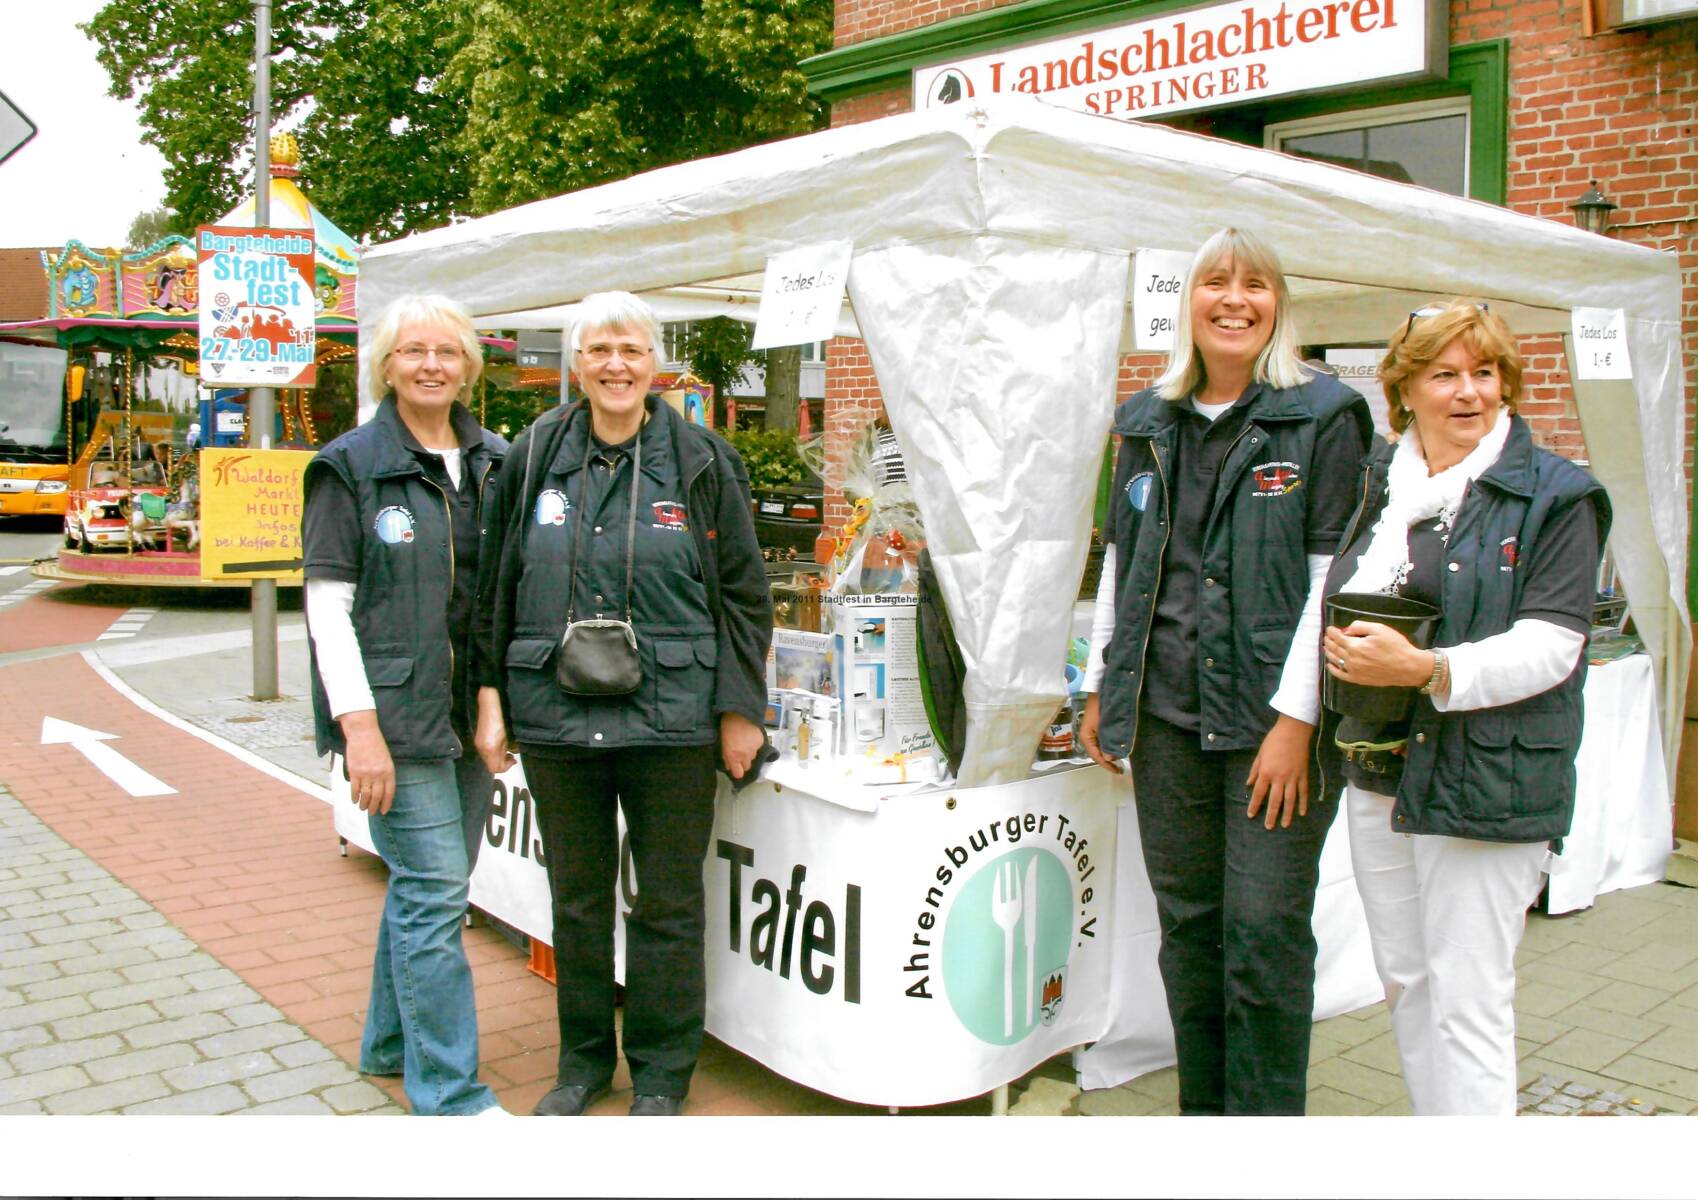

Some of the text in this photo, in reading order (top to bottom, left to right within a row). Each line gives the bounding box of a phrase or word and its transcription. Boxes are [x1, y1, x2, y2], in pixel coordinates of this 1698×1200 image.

[989, 0, 1398, 95] Landschlachterei
[1085, 62, 1269, 115] SPRINGER
[202, 231, 311, 254] Bargteheide
[247, 278, 301, 306] fest
[1146, 274, 1181, 294] Jede
[1580, 325, 1618, 340] Jedes Los
[278, 342, 314, 362] Mai
[0, 467, 27, 476] AFT
[247, 503, 300, 517] HEUTE
[903, 813, 1097, 999] Ahrensburger Tafel e.V.
[717, 838, 862, 1005] Tafel
